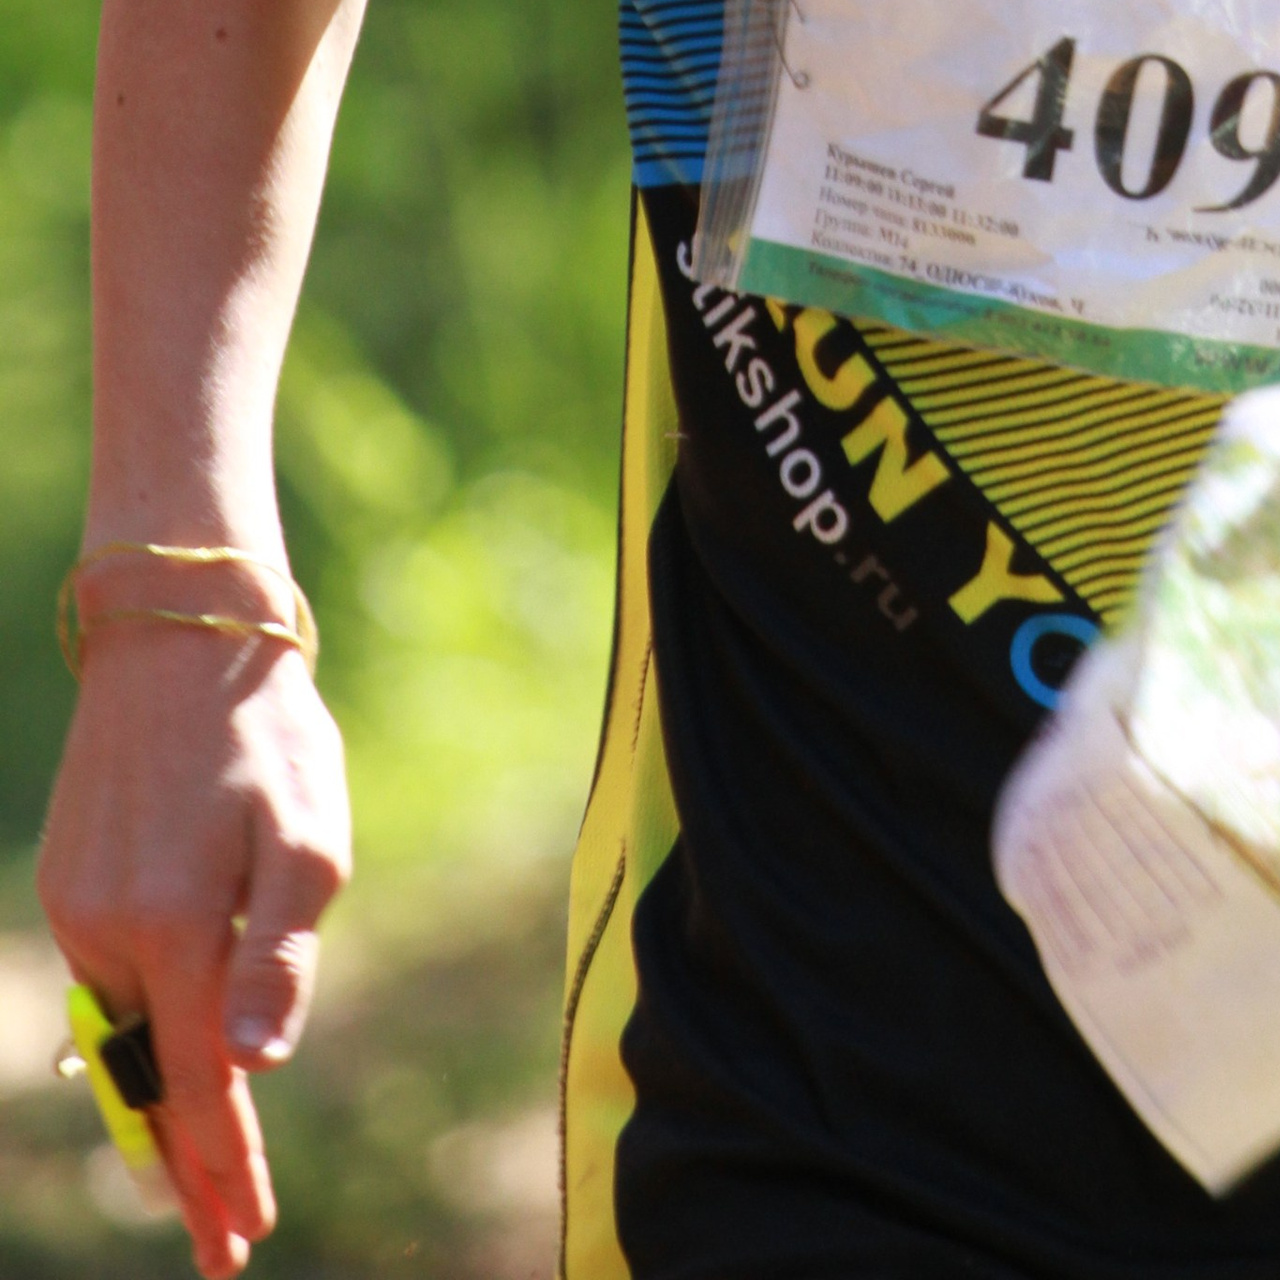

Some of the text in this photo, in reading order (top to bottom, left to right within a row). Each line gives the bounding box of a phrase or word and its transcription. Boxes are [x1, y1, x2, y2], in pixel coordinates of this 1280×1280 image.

[901, 168, 956, 200] Сергей
[819, 186, 869, 218] Номер
[766, 296, 951, 525] UN
